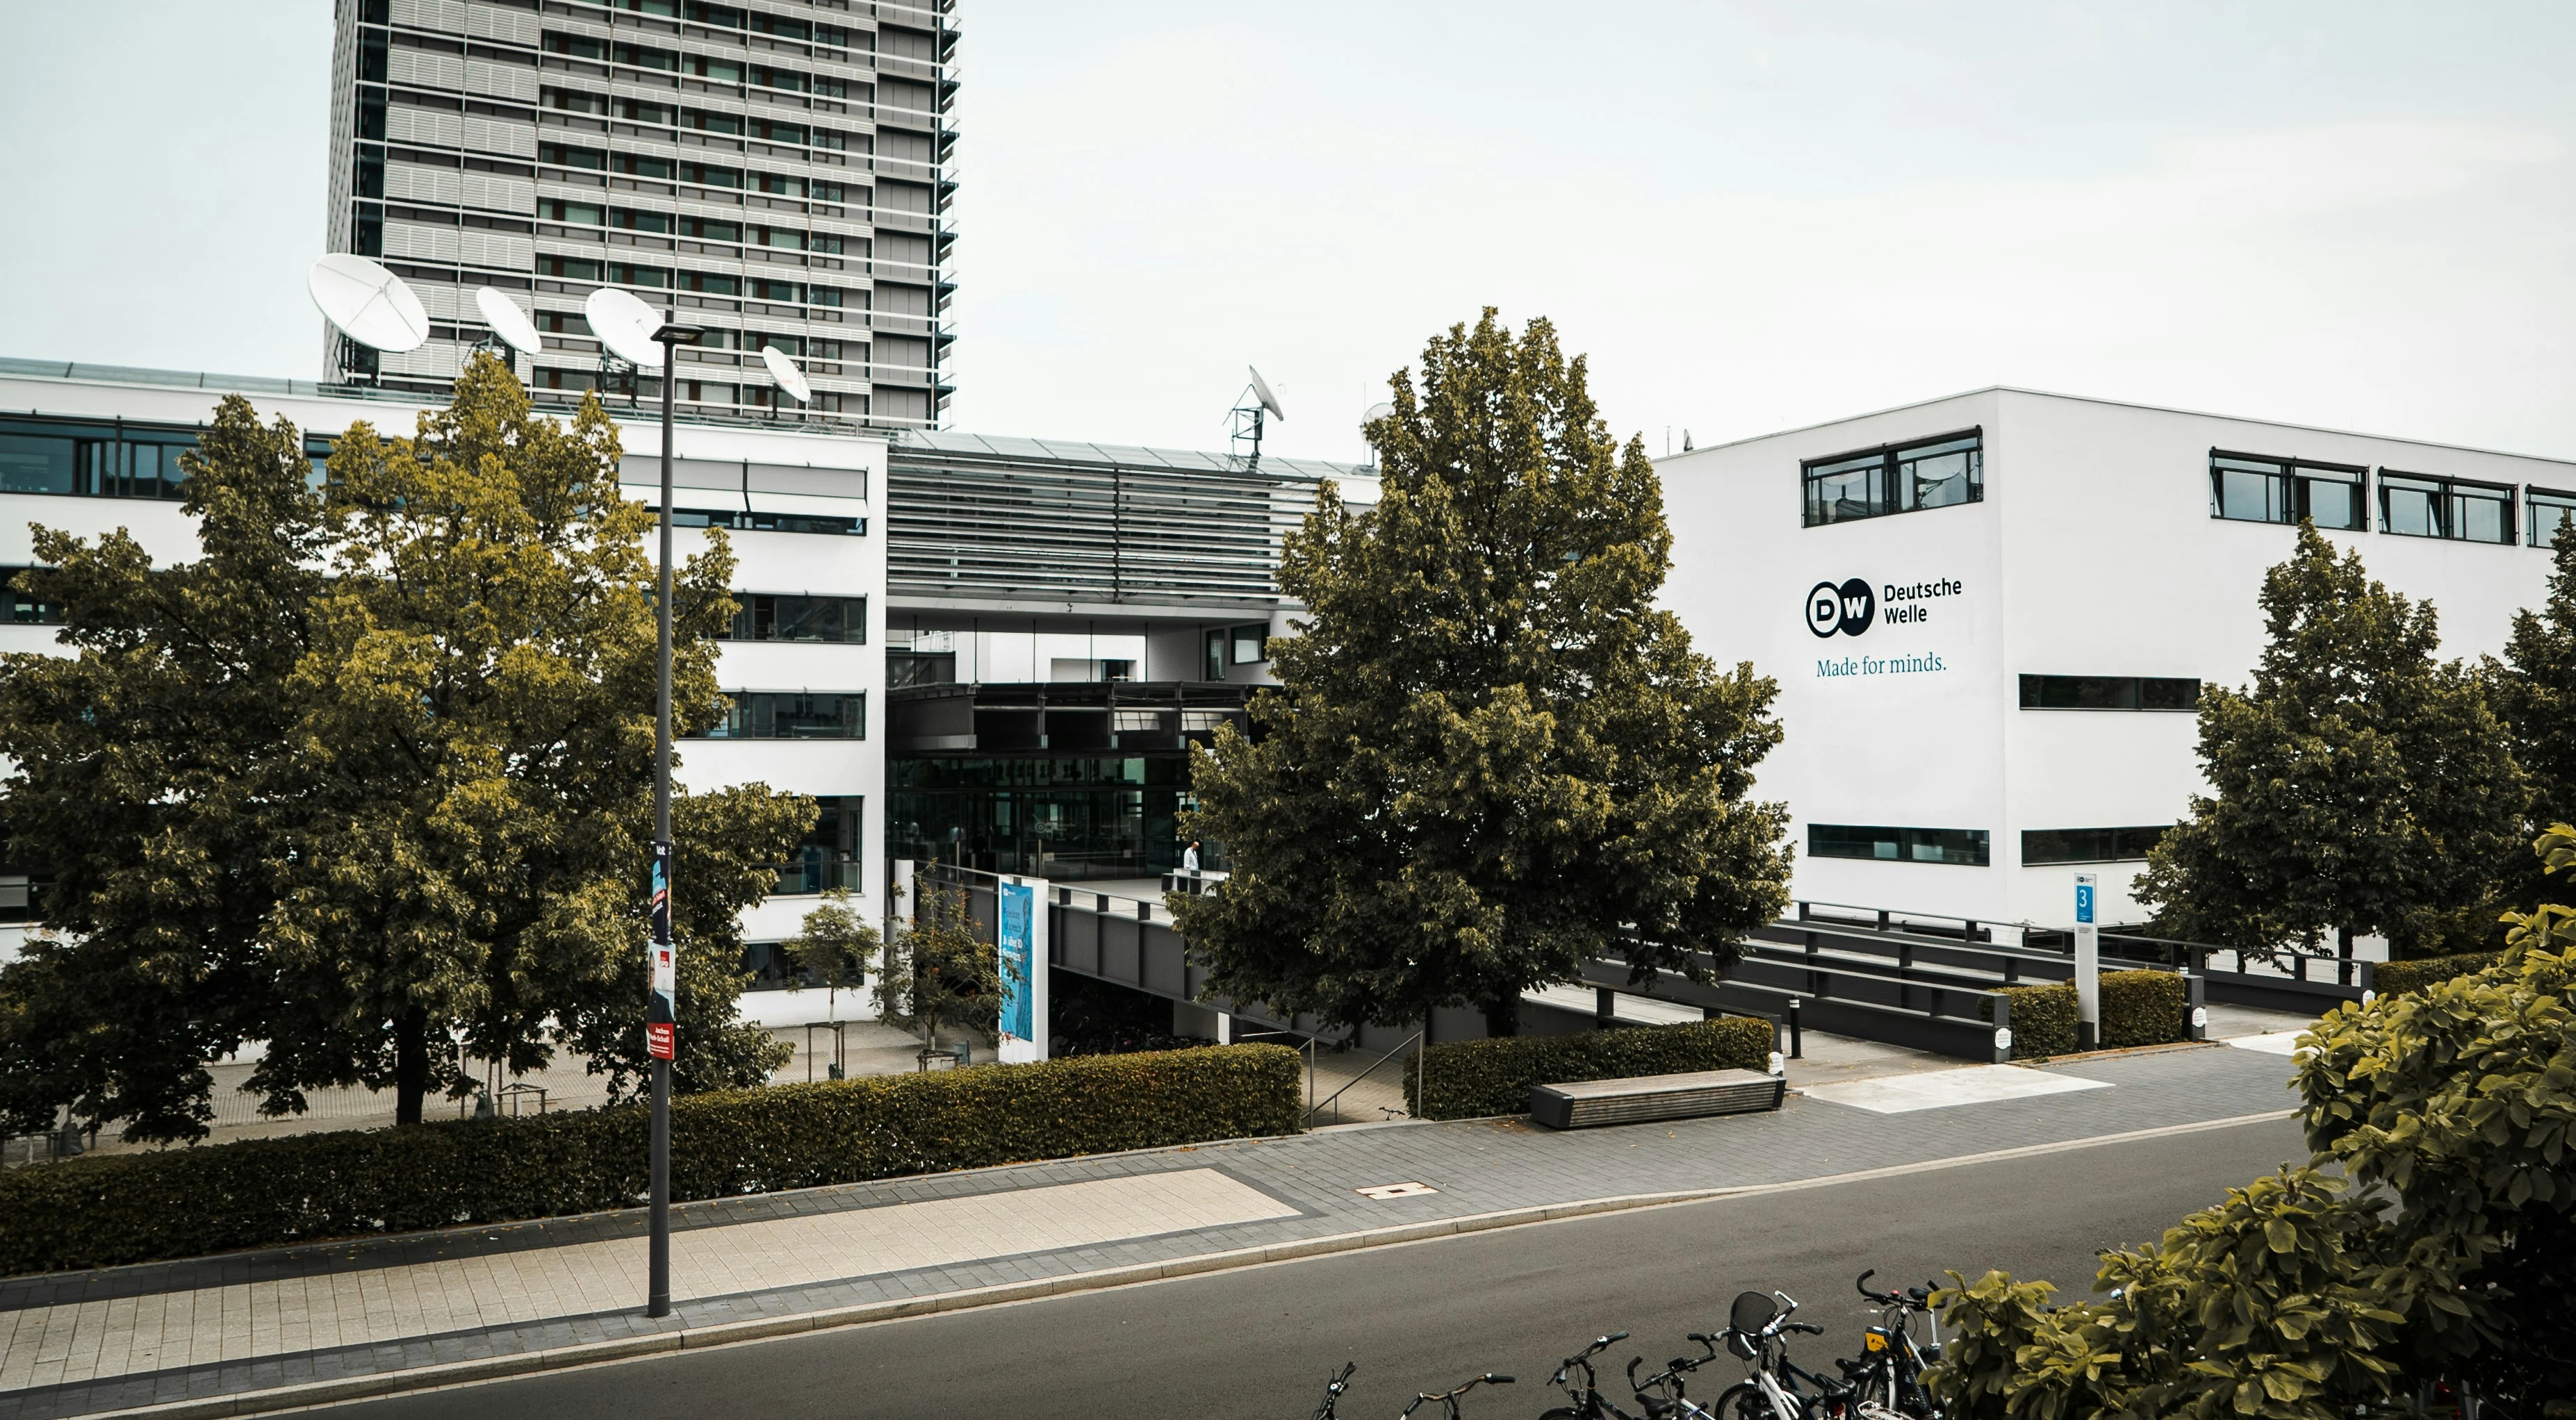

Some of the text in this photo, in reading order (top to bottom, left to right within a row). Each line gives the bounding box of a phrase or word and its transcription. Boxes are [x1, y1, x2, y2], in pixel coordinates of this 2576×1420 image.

[1884, 577, 1962, 602] Deutsche
[1884, 604, 1927, 625] Welle
[1816, 652, 1946, 677] Made for minds.
[2078, 889, 2087, 907] 3
